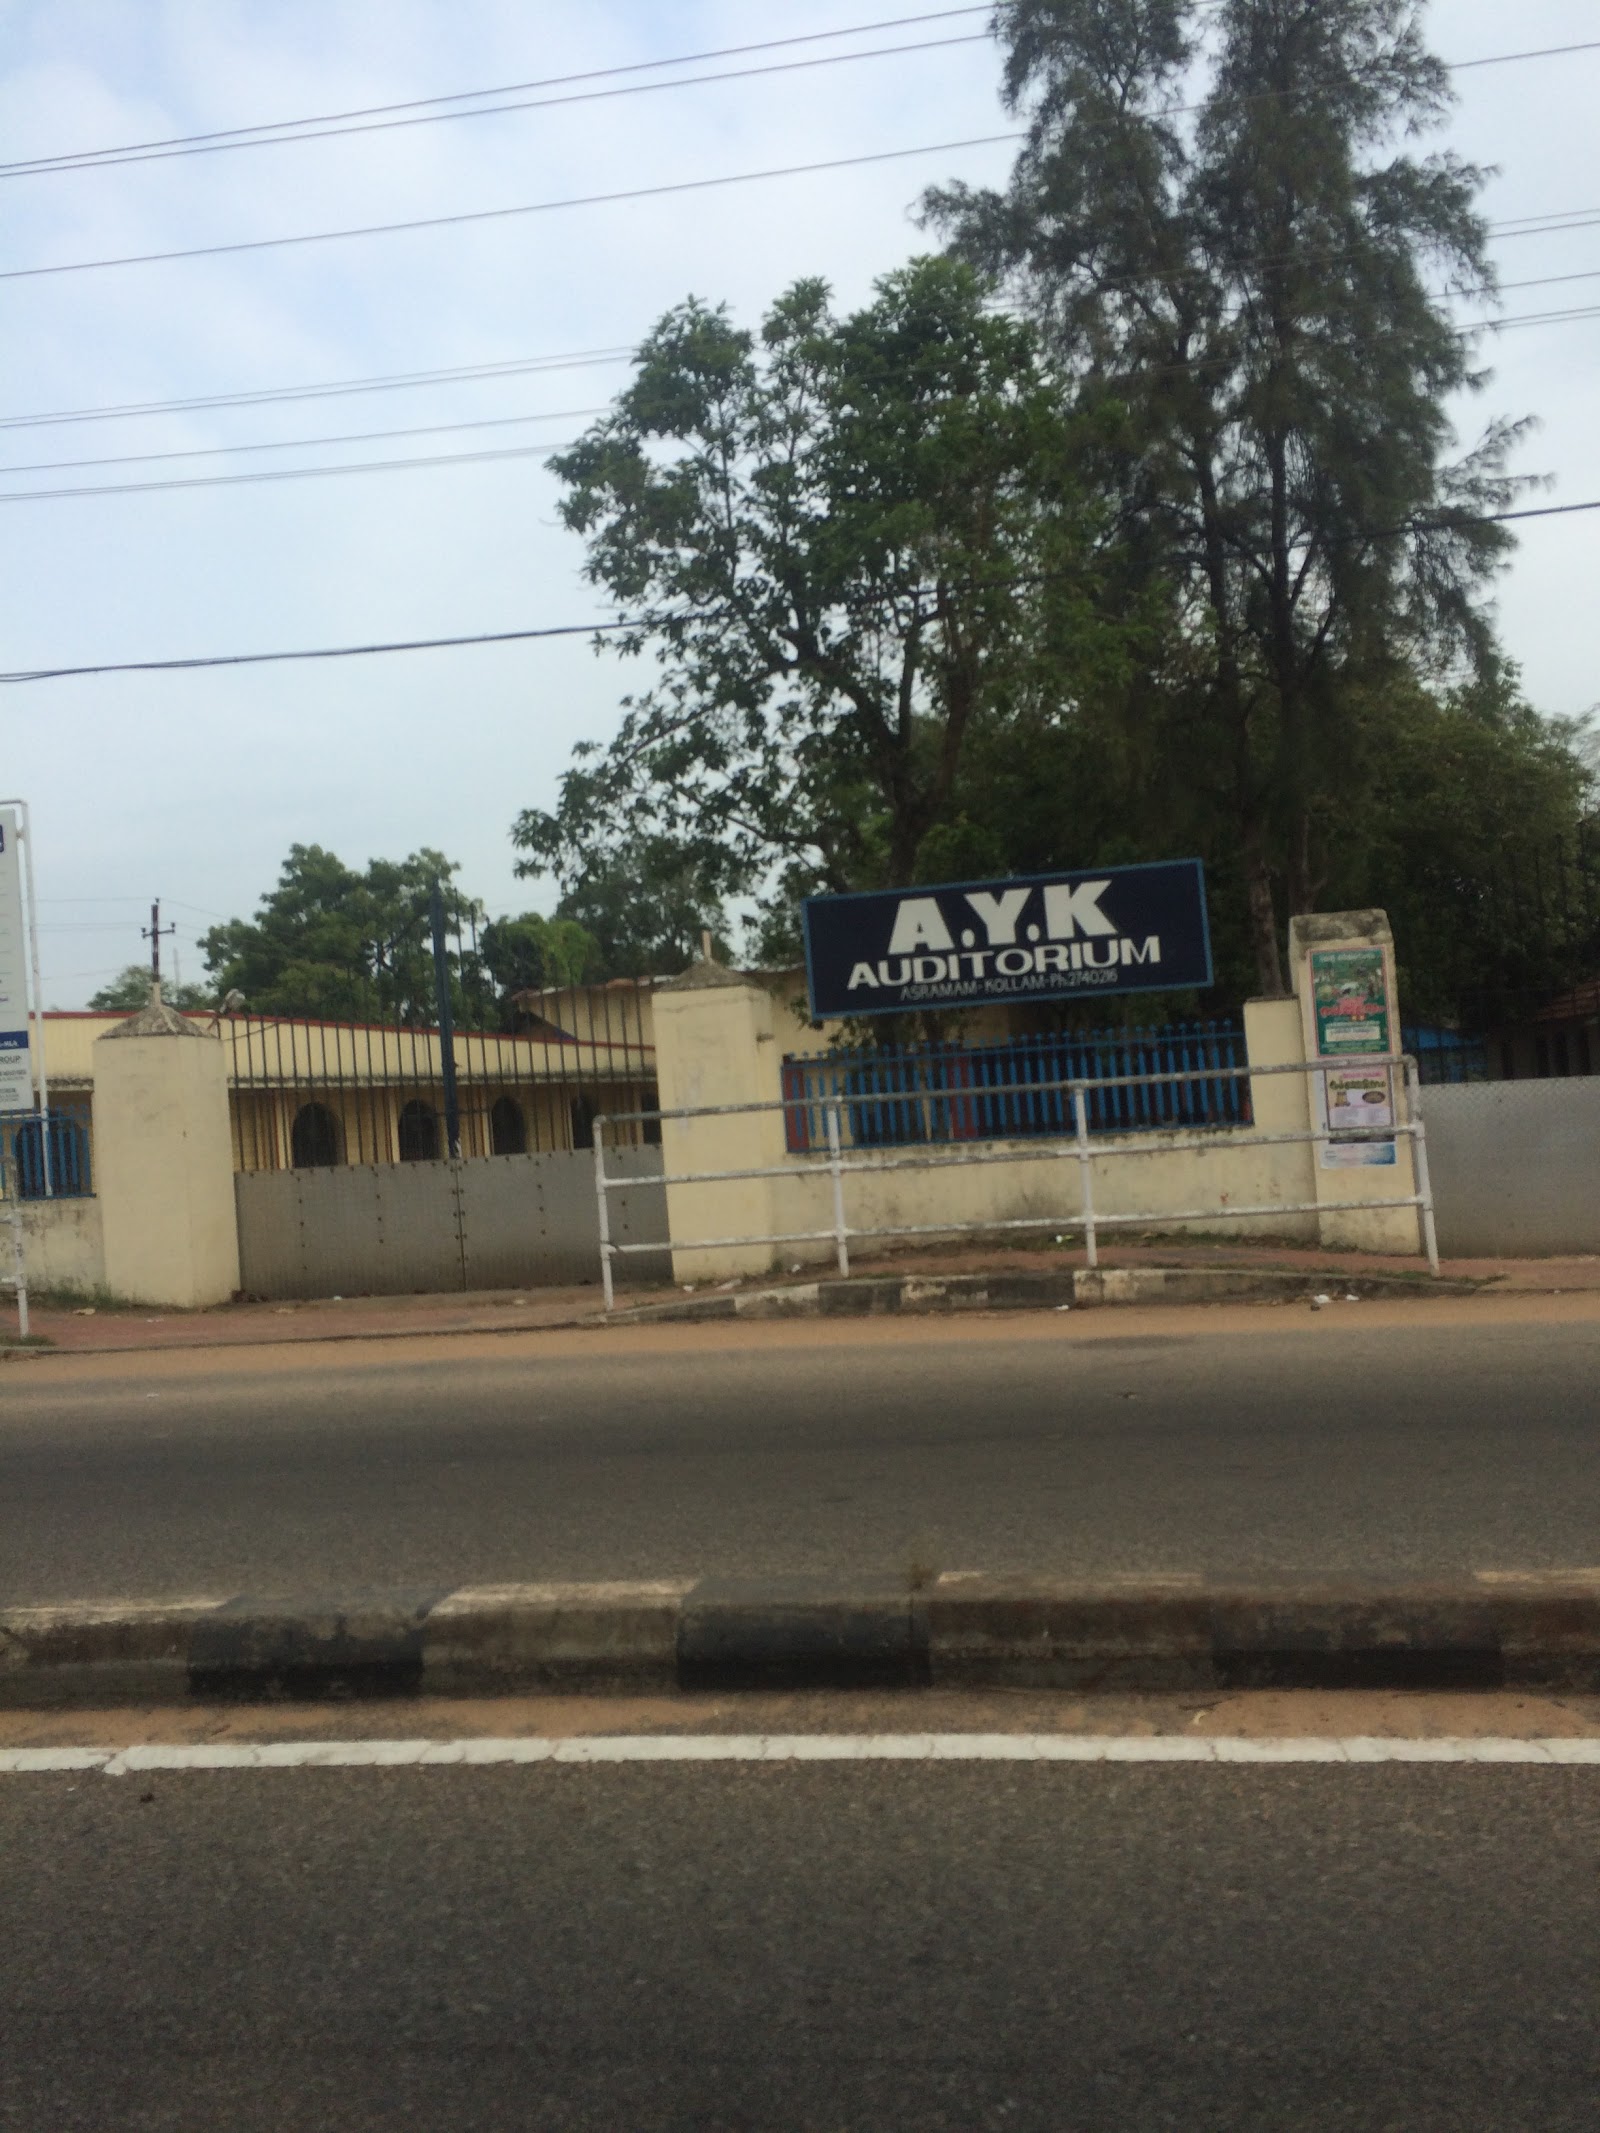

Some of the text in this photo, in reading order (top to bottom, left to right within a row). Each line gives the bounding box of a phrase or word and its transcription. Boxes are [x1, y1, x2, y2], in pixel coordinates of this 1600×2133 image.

[887, 879, 1117, 956] A.Y.K
[847, 935, 1161, 991] AUDITORIUM
[0, 1055, 21, 1064] ROUP
